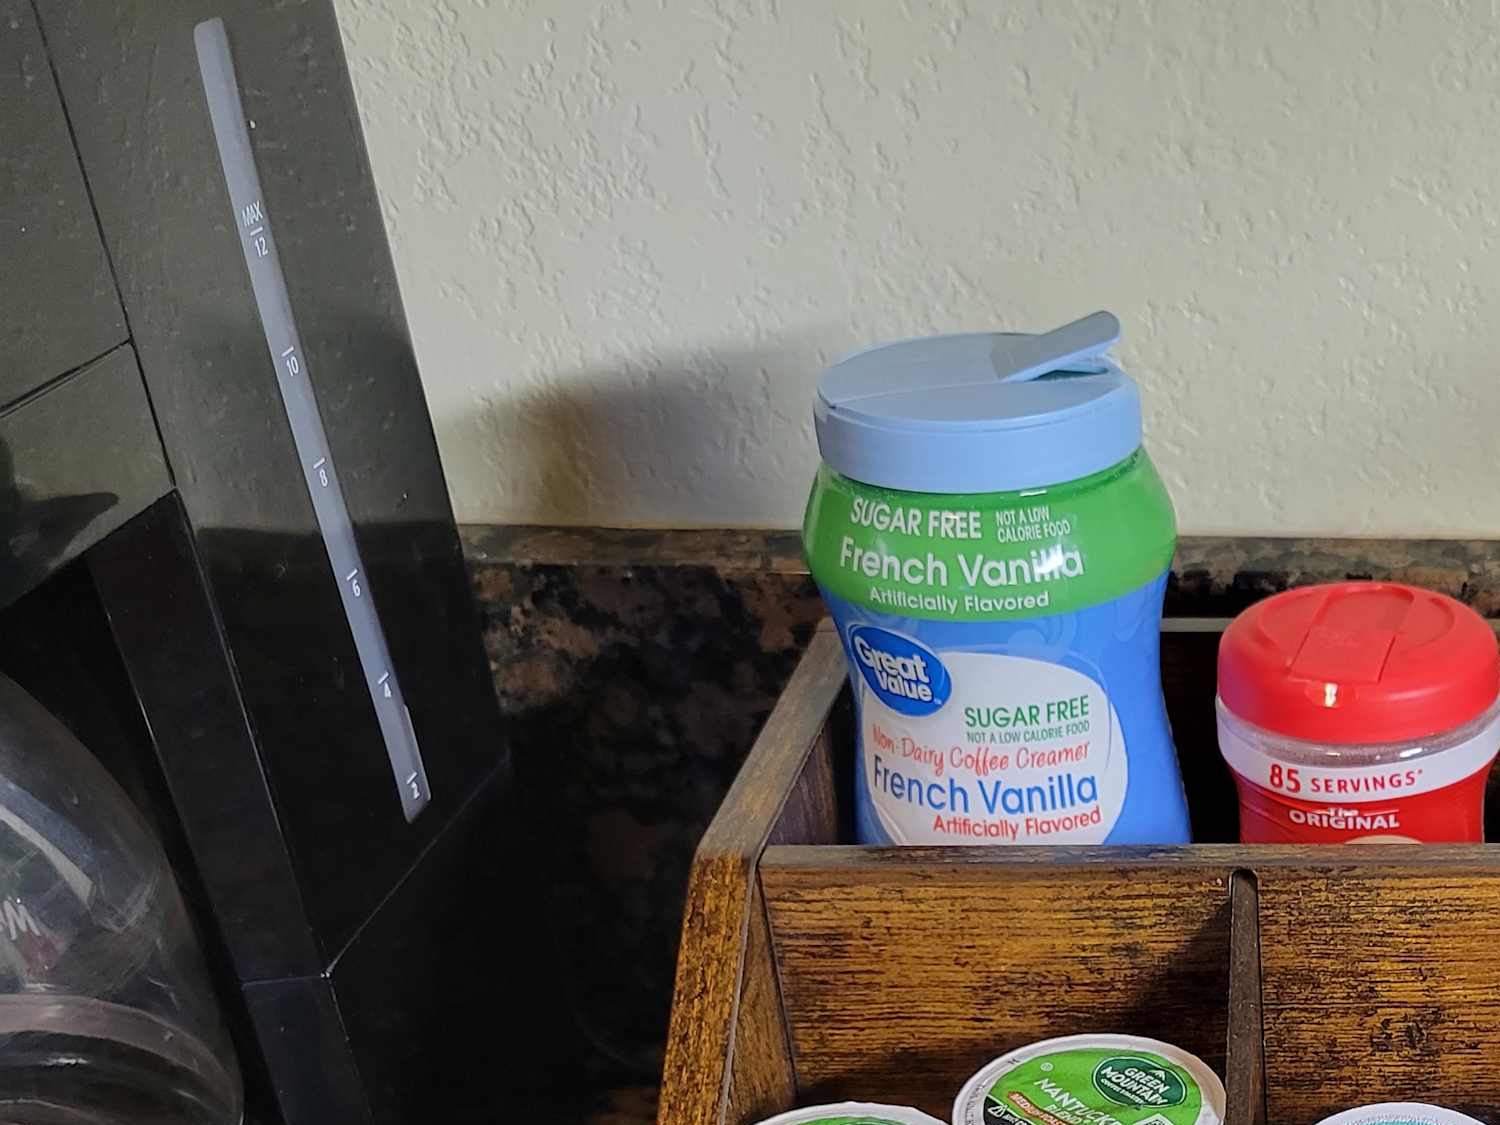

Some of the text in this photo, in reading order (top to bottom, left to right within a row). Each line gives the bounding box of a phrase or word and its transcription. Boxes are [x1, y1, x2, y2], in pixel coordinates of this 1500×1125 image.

[241, 200, 264, 227] MAX
[255, 236, 269, 258] 12
[286, 356, 299, 377] 10
[319, 468, 329, 488] 8
[849, 497, 982, 540] SUGAR FREE
[996, 505, 1050, 527] NOT A LOW
[997, 519, 1071, 544] CALORIE FOOD
[839, 536, 1085, 590] French Vanilla
[351, 578, 361, 598] 6
[868, 586, 1050, 616] Artificially Flavored
[854, 635, 930, 684] Great
[382, 682, 392, 698] 4
[877, 671, 933, 702] Value
[963, 694, 1090, 730] SUGAR FREE
[966, 719, 1091, 745] NOT A LOW CALORIE FOOD
[901, 736, 945, 776] Dairy
[950, 743, 1010, 776] Coffee
[1015, 739, 1091, 771] Creamer
[409, 780, 420, 800] 2
[873, 753, 1099, 816] French Vanilla
[1269, 763, 1302, 794] 85
[933, 805, 1101, 841] Artificially Flavored
[1288, 809, 1401, 831] ORIGINAL
[1100, 1066, 1169, 1105] MOUNTAIN
[1124, 1068, 1171, 1094] GREEN
[1008, 1092, 1041, 1117] MEDIUM
[1043, 1104, 1083, 1125] BLEND
